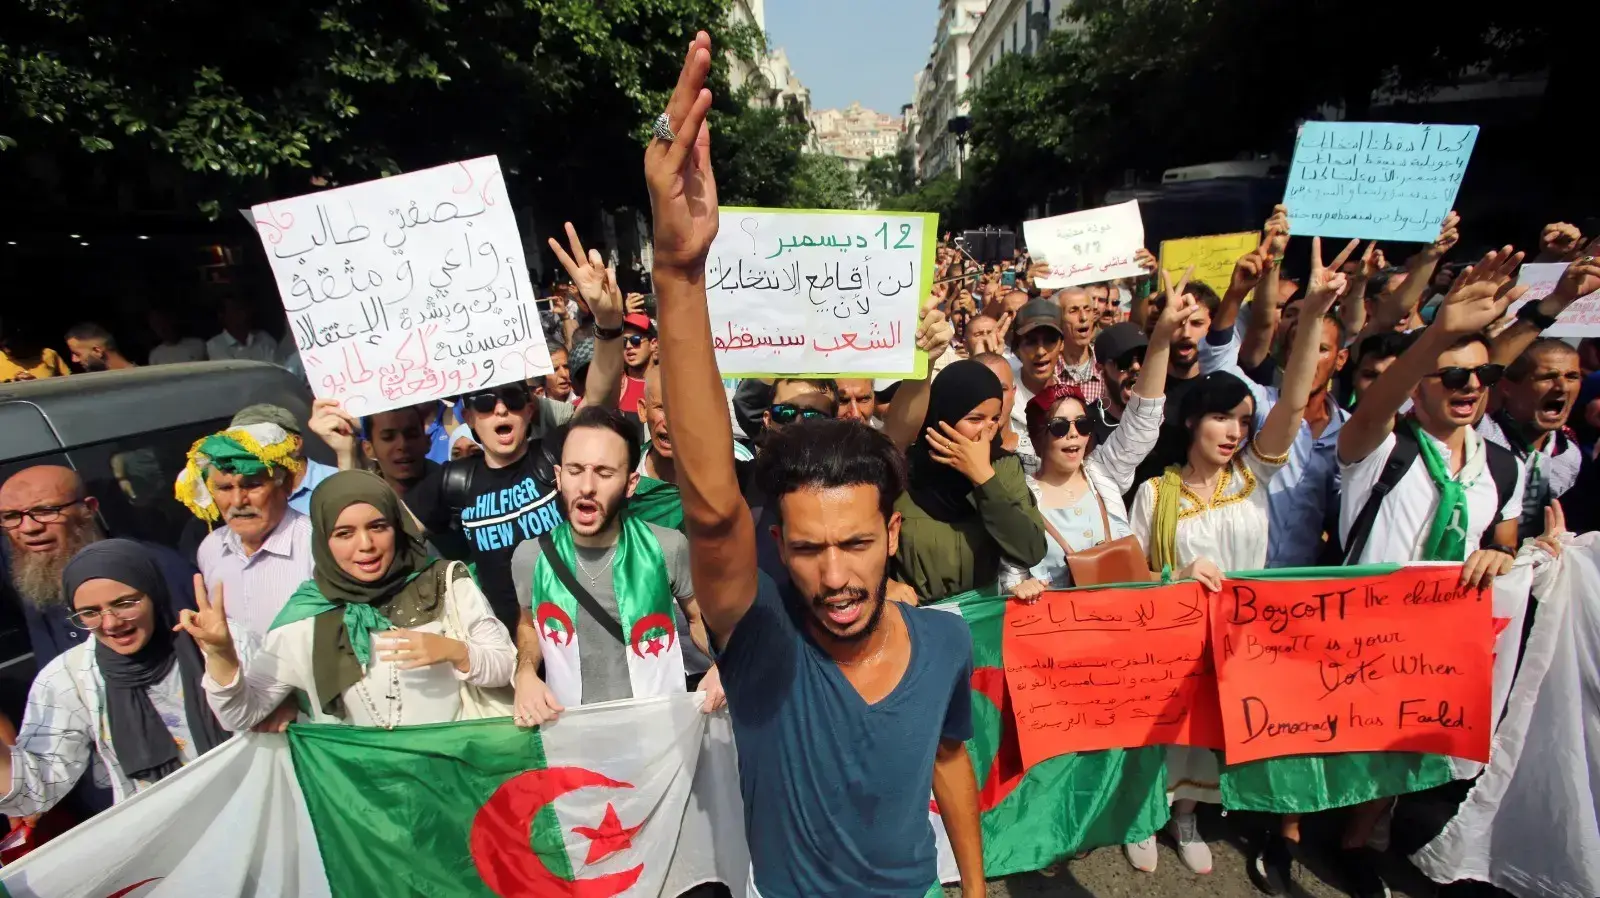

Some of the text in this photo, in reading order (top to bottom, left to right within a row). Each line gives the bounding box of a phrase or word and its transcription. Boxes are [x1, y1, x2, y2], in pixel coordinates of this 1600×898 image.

[274, 200, 371, 265] طالب
[765, 232, 868, 260] ديسمبر
[874, 221, 915, 250] 12
[805, 255, 872, 306] أقاطع
[877, 261, 914, 297] لن
[475, 521, 515, 552] NEW
[517, 500, 564, 541] YORK
[1223, 633, 1235, 661] A
[1325, 637, 1341, 651] is
[1345, 631, 1406, 658] your
[1317, 657, 1384, 693] Vote
[1239, 696, 1339, 744] Democracy
[1349, 702, 1385, 728] has
